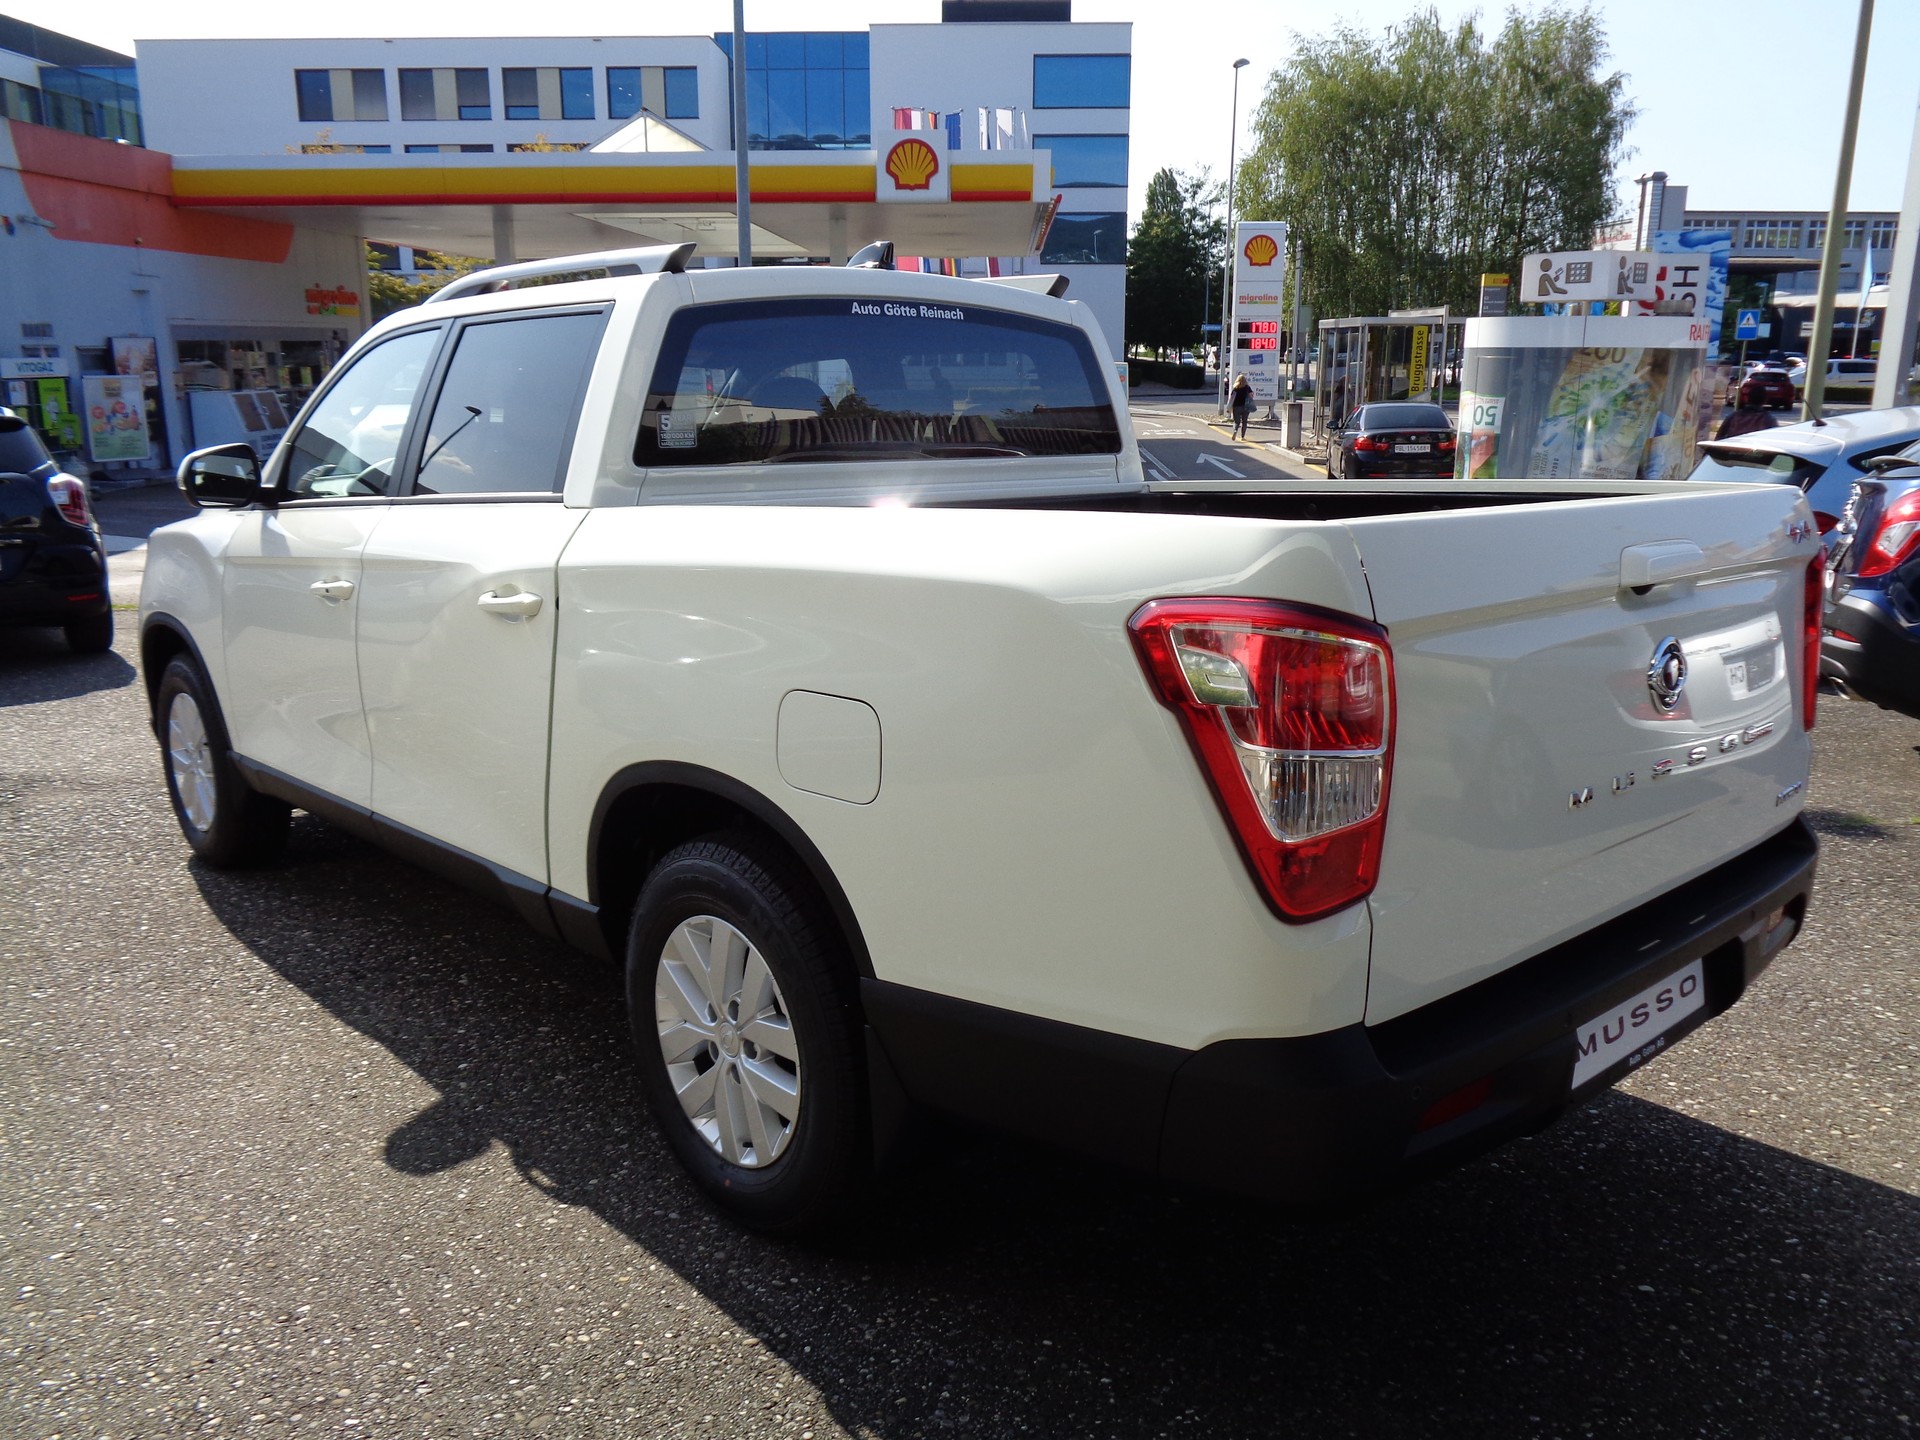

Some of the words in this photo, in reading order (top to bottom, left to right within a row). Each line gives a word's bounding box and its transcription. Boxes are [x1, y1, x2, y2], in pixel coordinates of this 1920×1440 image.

[1239, 293, 1278, 301] migrolino
[851, 301, 880, 315] Auto
[884, 303, 917, 317] Götte
[920, 305, 964, 320] Reinach
[1411, 330, 1424, 392] Bruggstrasse
[661, 414, 671, 431] 5
[1474, 405, 1498, 426] 50
[1568, 733, 1740, 812] MUSSO
[1579, 974, 1697, 1056] MUSSO
